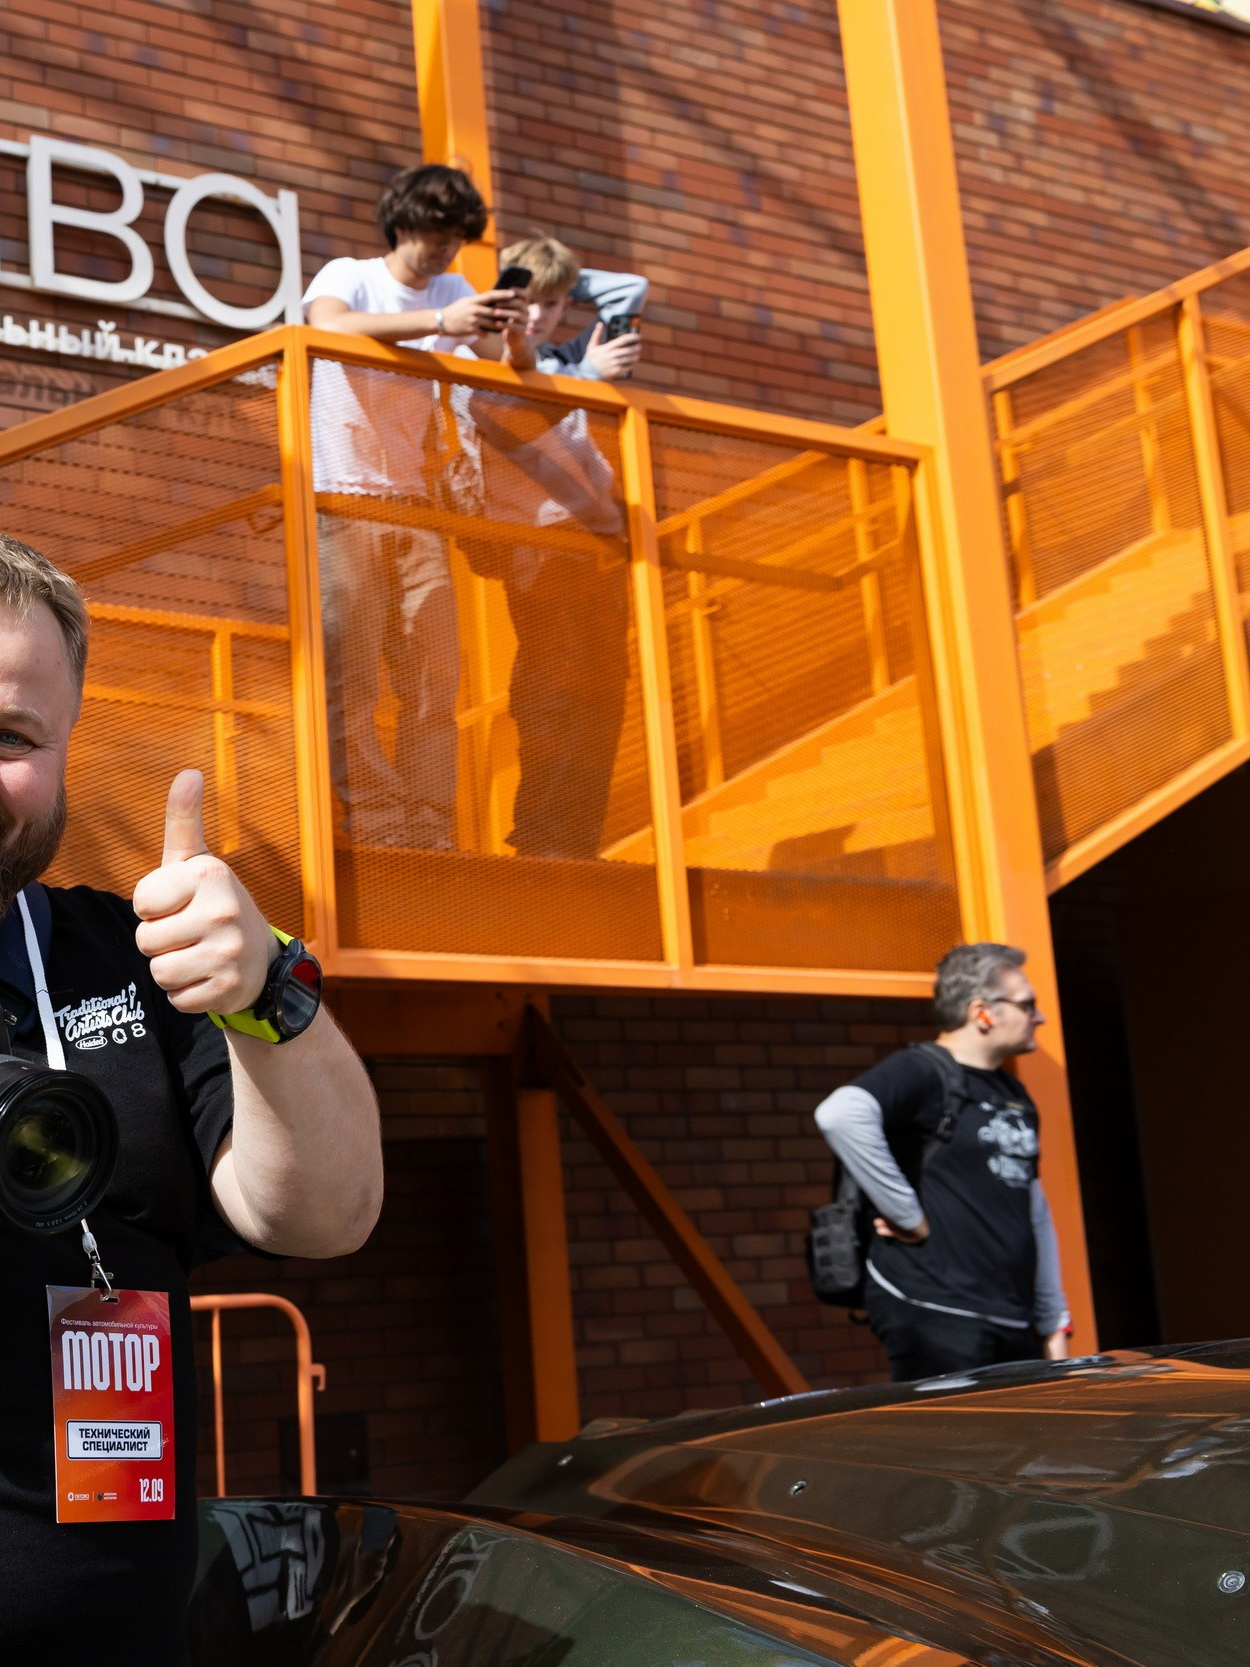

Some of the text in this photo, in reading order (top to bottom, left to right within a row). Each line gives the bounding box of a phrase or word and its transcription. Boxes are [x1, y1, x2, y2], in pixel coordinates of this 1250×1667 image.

[53, 989, 127, 1027] Traditional
[111, 1001, 145, 1025] Club
[61, 1318, 91, 1326] Фестиваль
[134, 1322, 158, 1331] культуры
[79, 1427, 151, 1439] ТЕХНИЧЕСКИЙ
[82, 1441, 148, 1453] СПЕЦИАЛИСТ
[139, 1478, 164, 1502] 12.09
